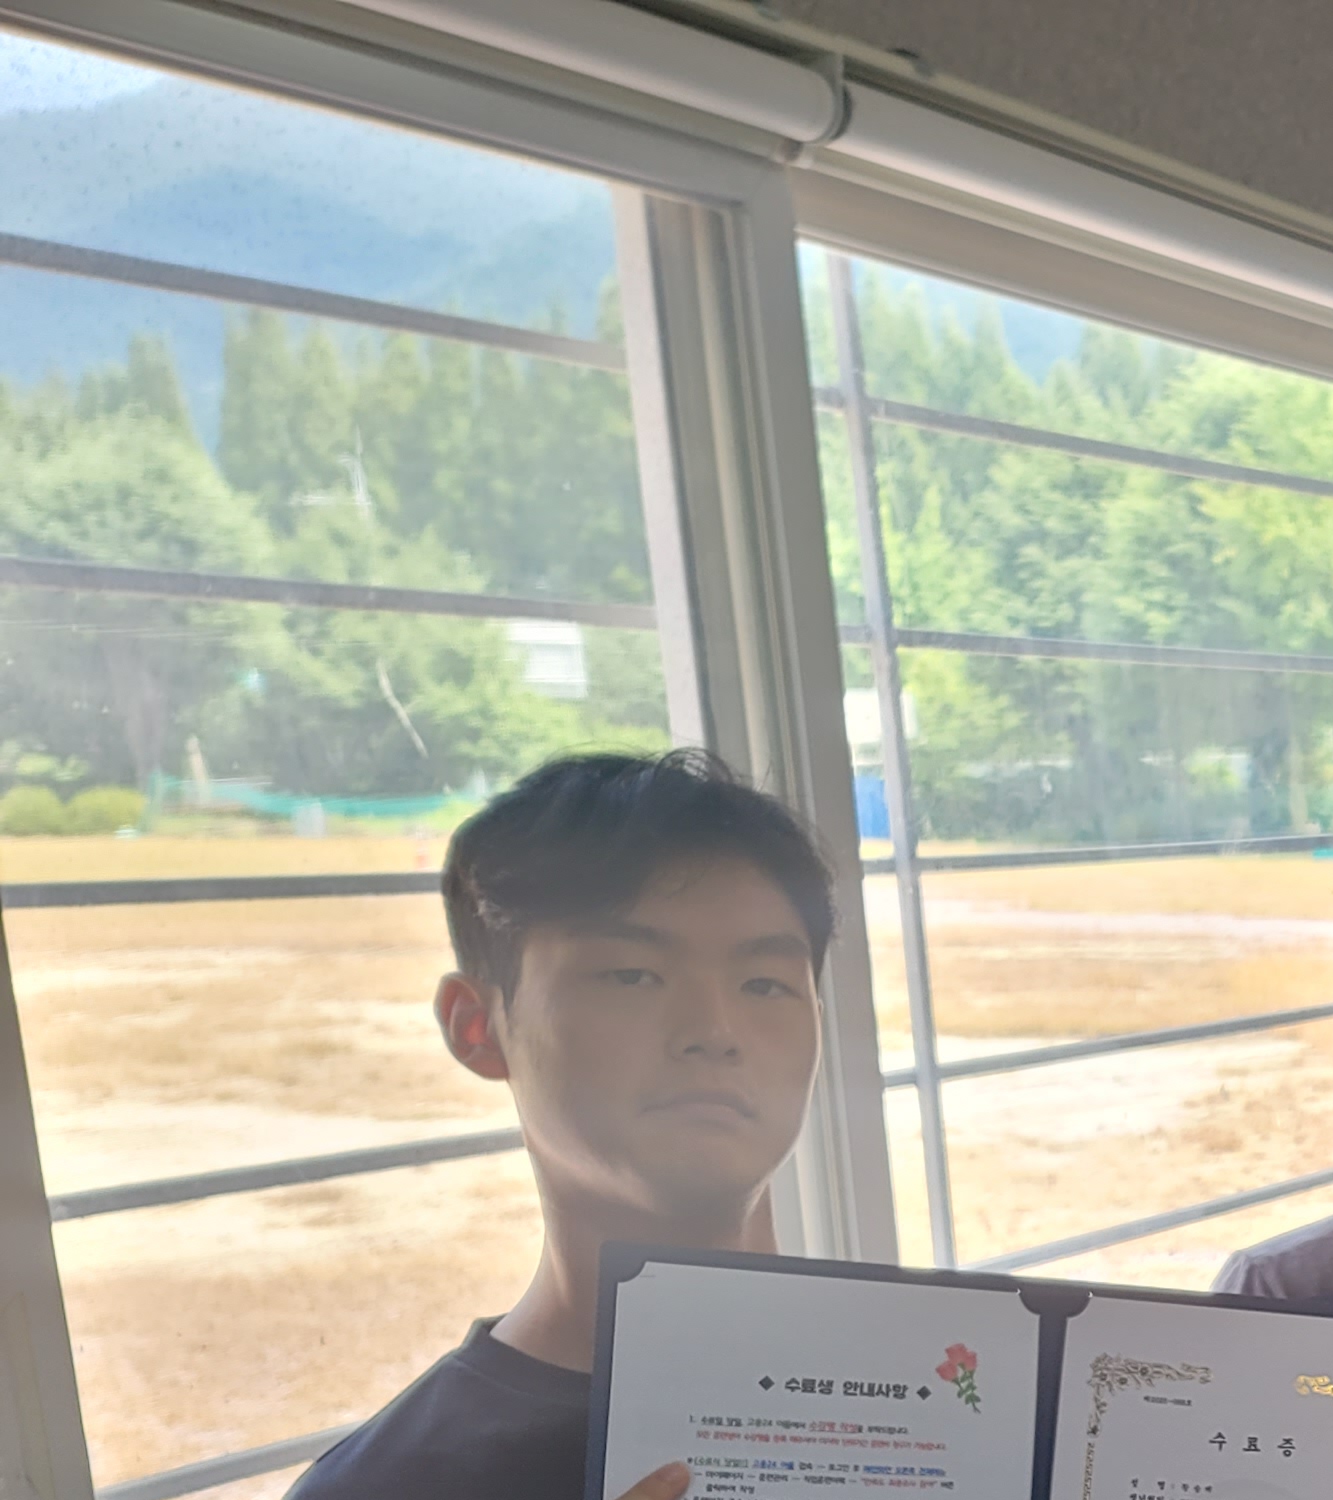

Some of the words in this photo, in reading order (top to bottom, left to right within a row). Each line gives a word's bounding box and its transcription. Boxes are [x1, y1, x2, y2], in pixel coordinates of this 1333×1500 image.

[784, 1377, 834, 1395] 수료생
[842, 1380, 908, 1400] 안내사항
[1208, 1432, 1296, 1457] 수료증
